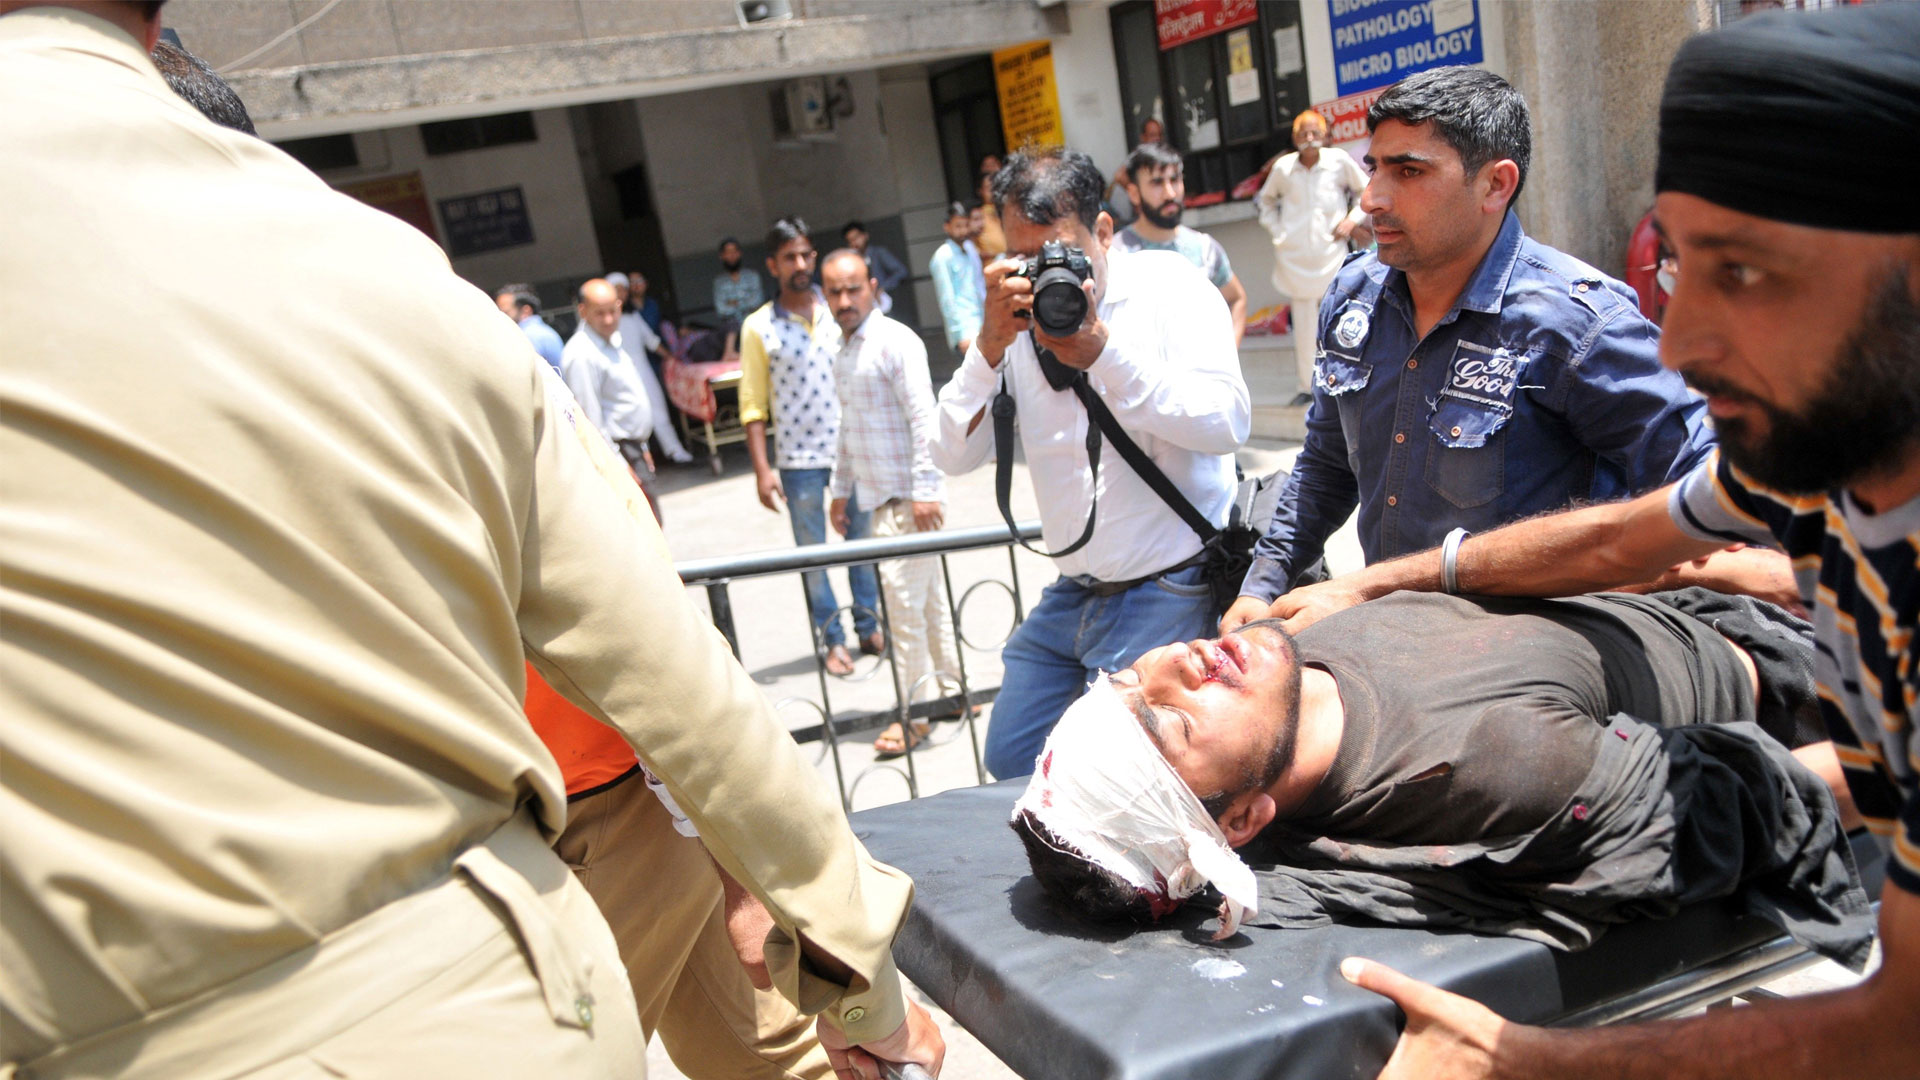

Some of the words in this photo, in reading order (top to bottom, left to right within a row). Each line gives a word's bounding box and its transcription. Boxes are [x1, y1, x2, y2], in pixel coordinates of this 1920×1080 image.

[1335, 2, 1433, 49] PATHOLOGY
[1339, 52, 1392, 84] MICRO
[1395, 28, 1475, 69] BIOLOGY
[1483, 357, 1517, 379] The
